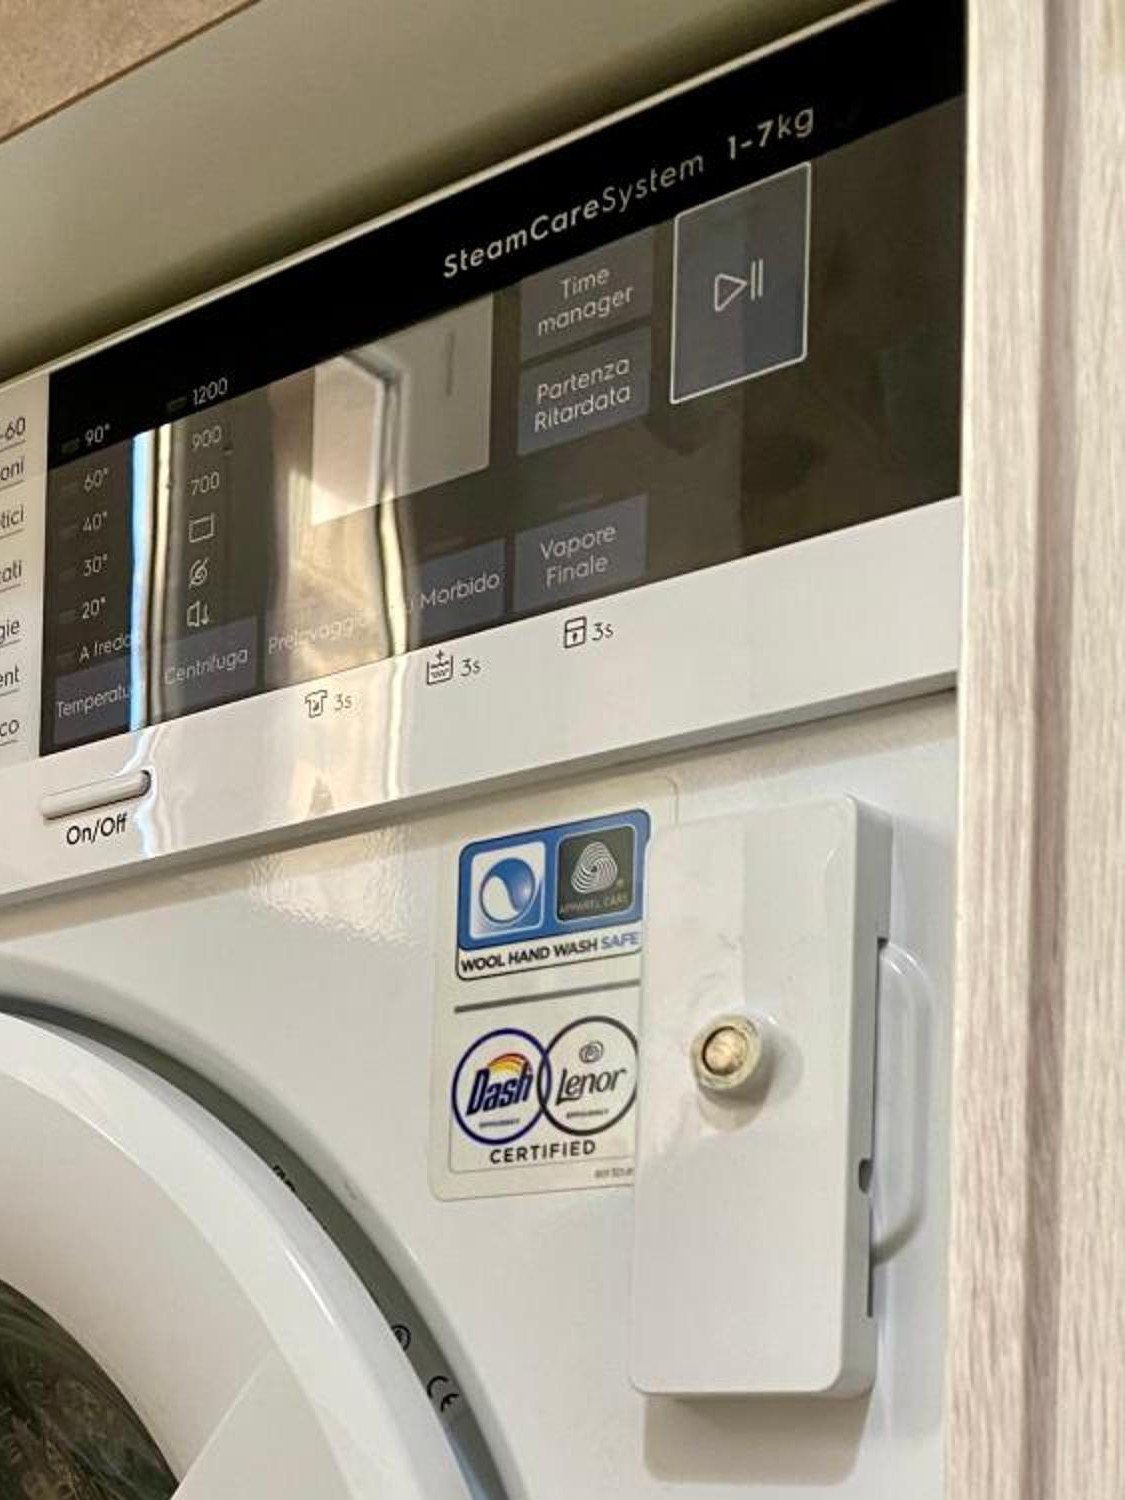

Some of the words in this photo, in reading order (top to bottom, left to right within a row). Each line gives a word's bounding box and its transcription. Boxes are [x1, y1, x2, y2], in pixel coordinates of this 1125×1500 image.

[443, 148, 705, 279] SteamCareSystem
[560, 265, 611, 300] Time
[537, 286, 635, 336] manager
[191, 377, 229, 406] 1200
[536, 356, 631, 404] Partenza
[533, 383, 632, 433] Ritardata
[84, 423, 111, 446] 90°
[191, 425, 222, 450] 900
[83, 468, 110, 493] 60°
[191, 471, 220, 495] 700
[82, 511, 108, 533] 40°
[539, 522, 617, 561] Vapore
[82, 553, 108, 577] 30°
[545, 555, 609, 589] Finale
[419, 571, 501, 609] Morbido
[81, 596, 107, 619] 20°
[591, 621, 614, 641] 3s
[78, 645, 90, 663] A
[164, 648, 249, 685] Centrifuga
[460, 658, 482, 677] 3s
[333, 692, 353, 712] 3s
[66, 811, 128, 845] On/Off
[461, 954, 506, 973] WOOL
[508, 946, 551, 965] HAND
[552, 938, 598, 958] WASH
[601, 931, 639, 950] SAFE
[466, 1058, 534, 1116] Dash
[554, 1067, 628, 1106] Lenor
[489, 1139, 597, 1164] CERTIFIED
